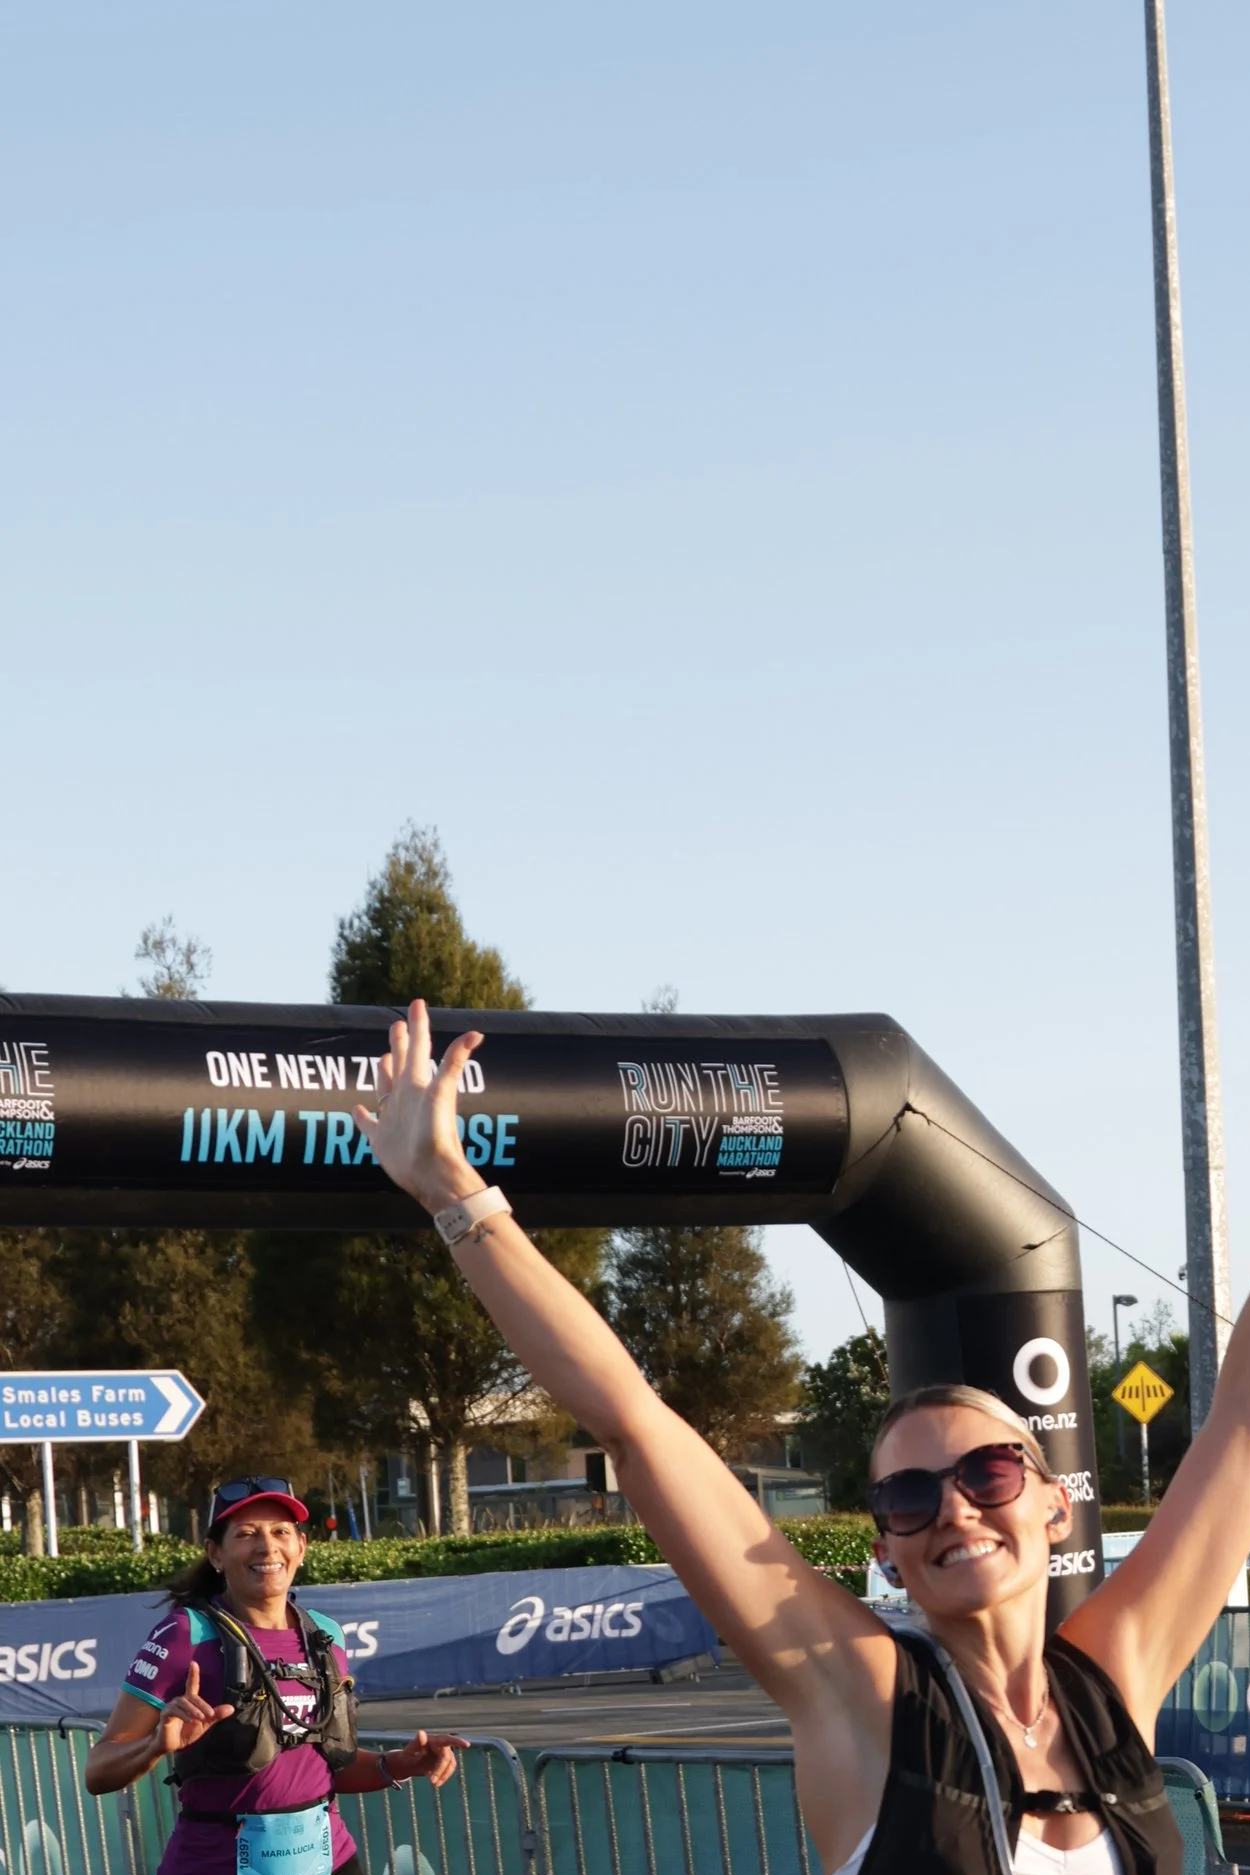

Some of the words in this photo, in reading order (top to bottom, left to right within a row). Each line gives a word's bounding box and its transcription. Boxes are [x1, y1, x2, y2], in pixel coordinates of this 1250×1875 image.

[206, 1050, 271, 1088] ONE
[275, 1053, 347, 1091] NEW
[617, 1062, 703, 1112] RUN
[701, 1063, 784, 1113] THE
[722, 1124, 773, 1134] THOMPSON
[732, 1116, 773, 1126] BARFOOT
[622, 1115, 719, 1167] CITY
[719, 1136, 784, 1151] AUCKLAND
[716, 1152, 781, 1167] MARATHON
[3, 1386, 81, 1403] Smales
[92, 1385, 146, 1402] Farm
[4, 1411, 66, 1428] Local
[76, 1410, 144, 1427] Buses
[261, 1849, 291, 1858] MARIA
[292, 1843, 315, 1856] LUCIA
[322, 1826, 330, 1857] 10397
[239, 1837, 249, 1870] 10397
